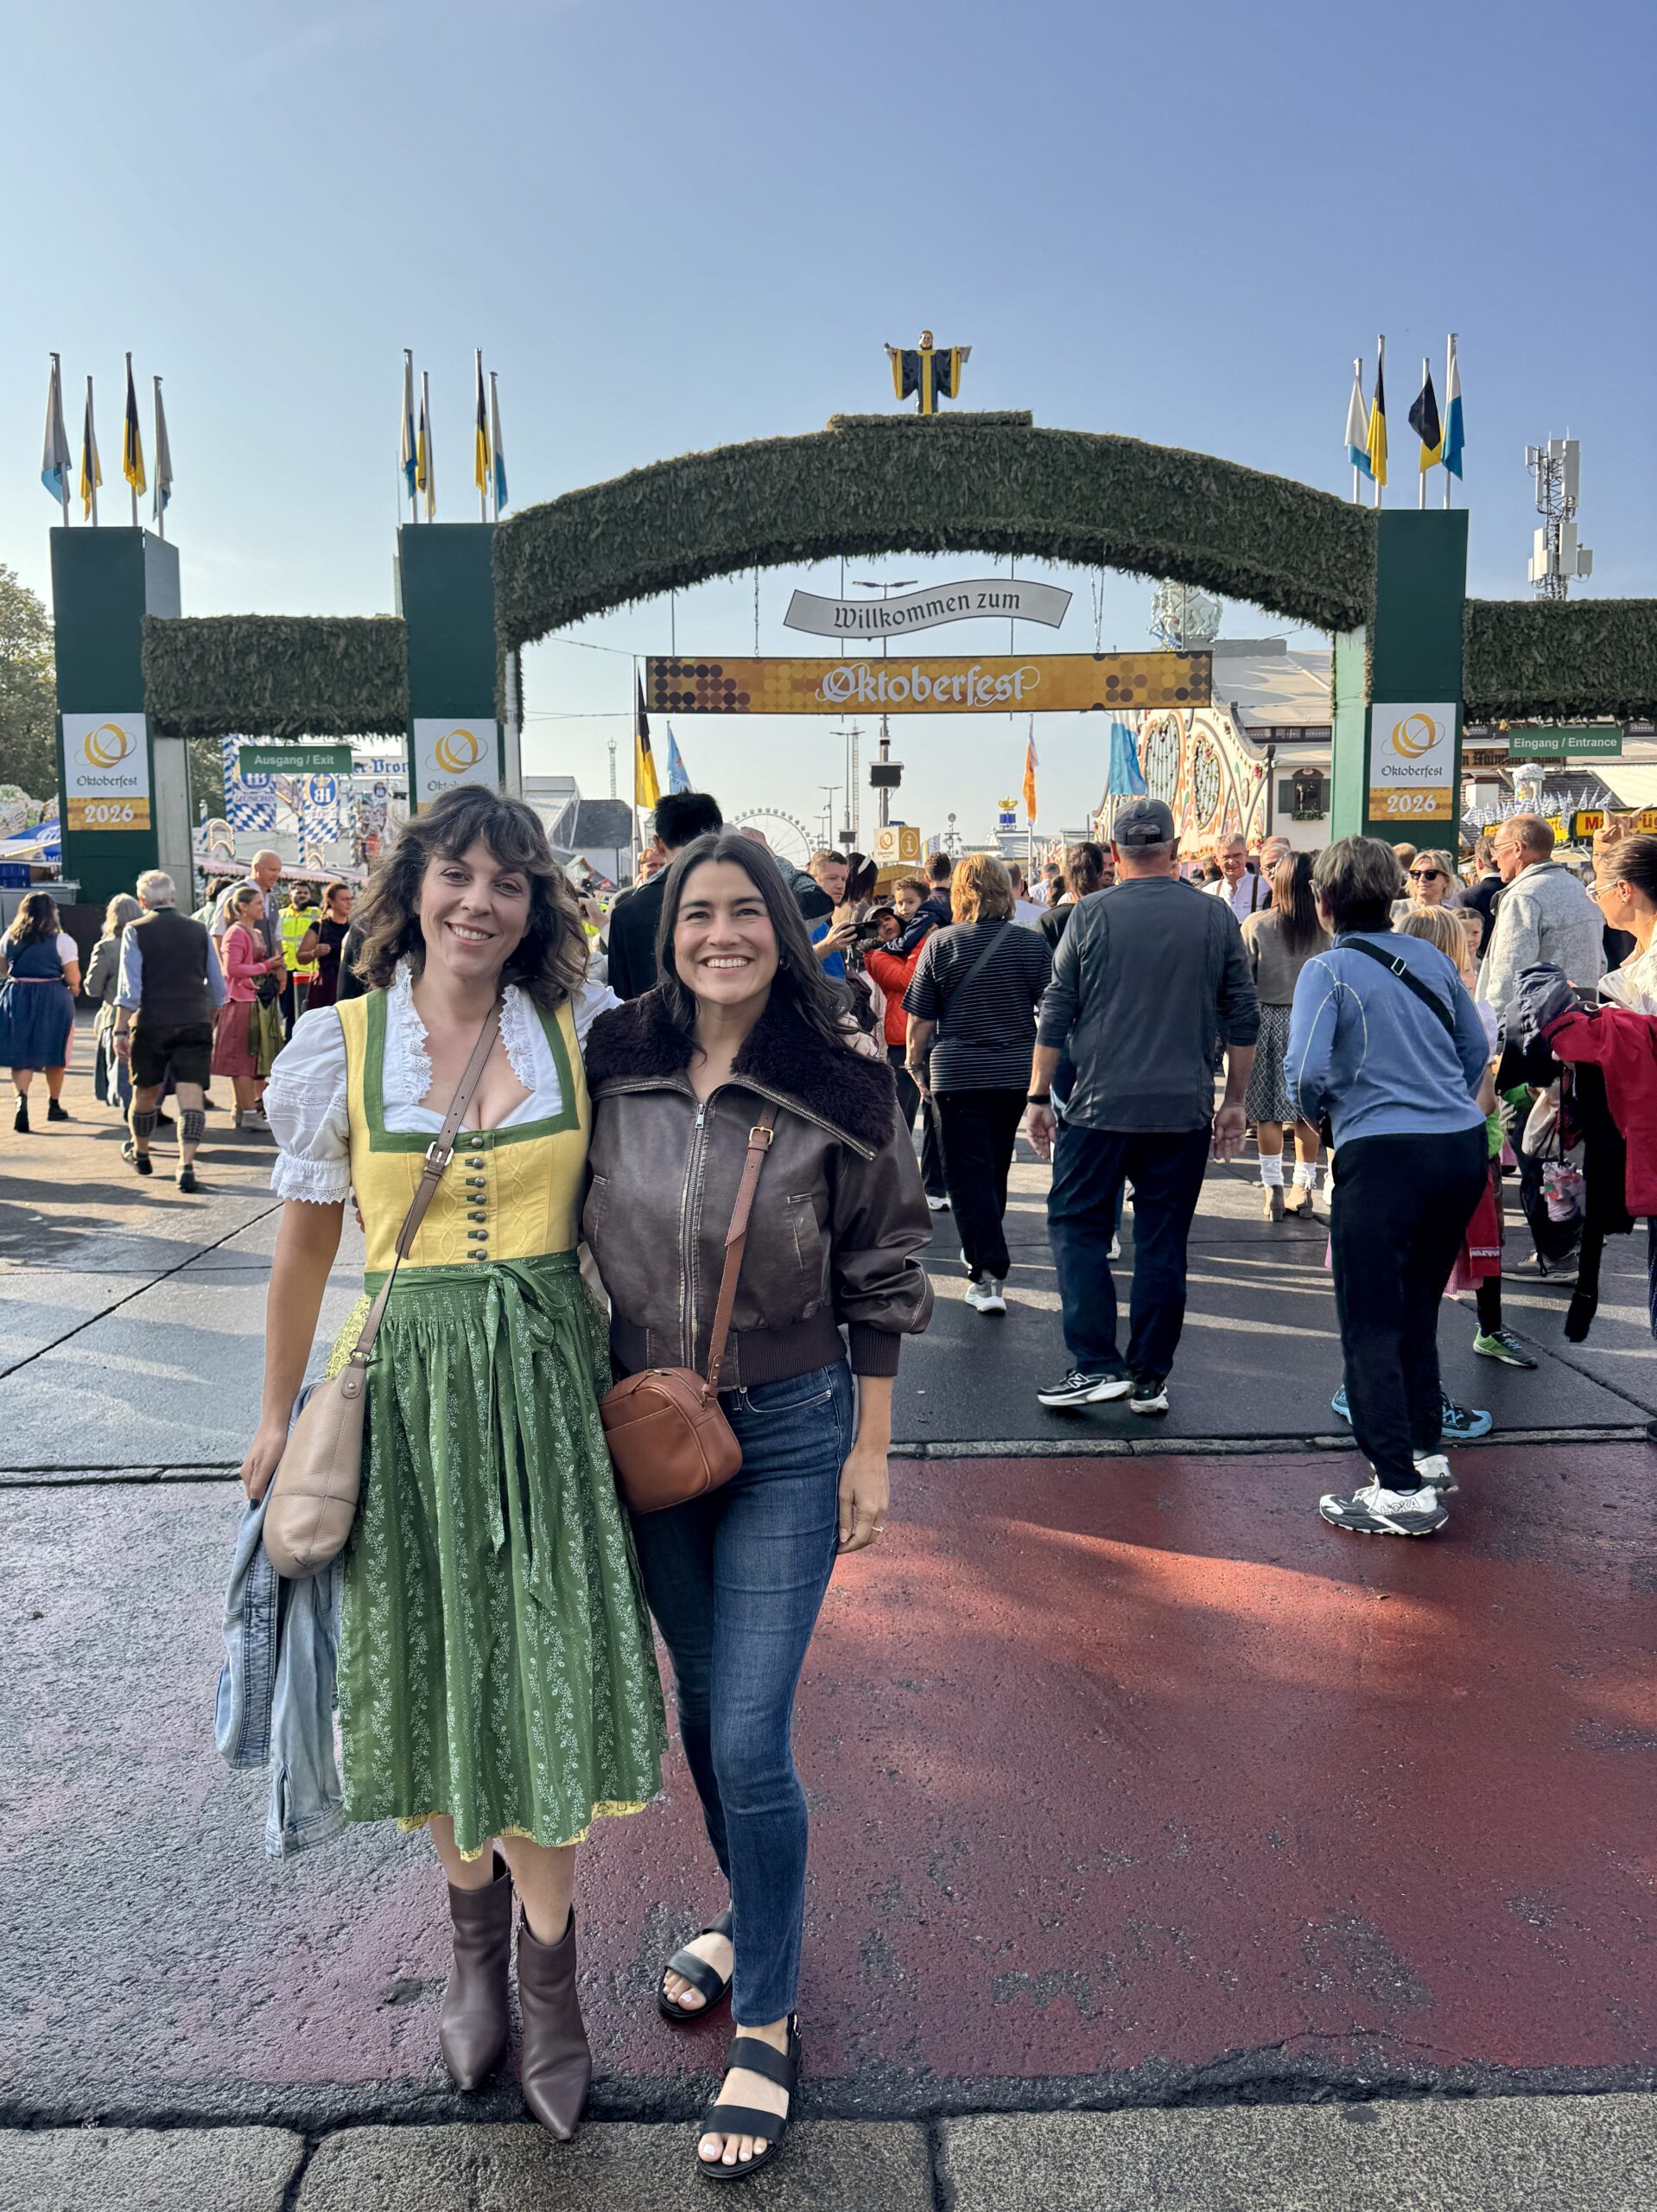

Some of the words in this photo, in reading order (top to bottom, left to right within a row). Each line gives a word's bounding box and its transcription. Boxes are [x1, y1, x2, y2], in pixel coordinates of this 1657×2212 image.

[834, 593, 970, 629] Willkommen
[976, 593, 1020, 609] zum
[815, 663, 1040, 708] Oktoberfest
[1514, 738, 1559, 750] Eingang
[1568, 737, 1618, 747] Entrance
[254, 754, 303, 767] Ausgang
[312, 754, 334, 765] Exit
[1381, 765, 1443, 778] Oktoberfest
[76, 775, 138, 788] Oktoberfest
[1387, 794, 1437, 813] 2026
[84, 804, 134, 823] 2026
[1381, 1497, 1420, 1516] HOKA
